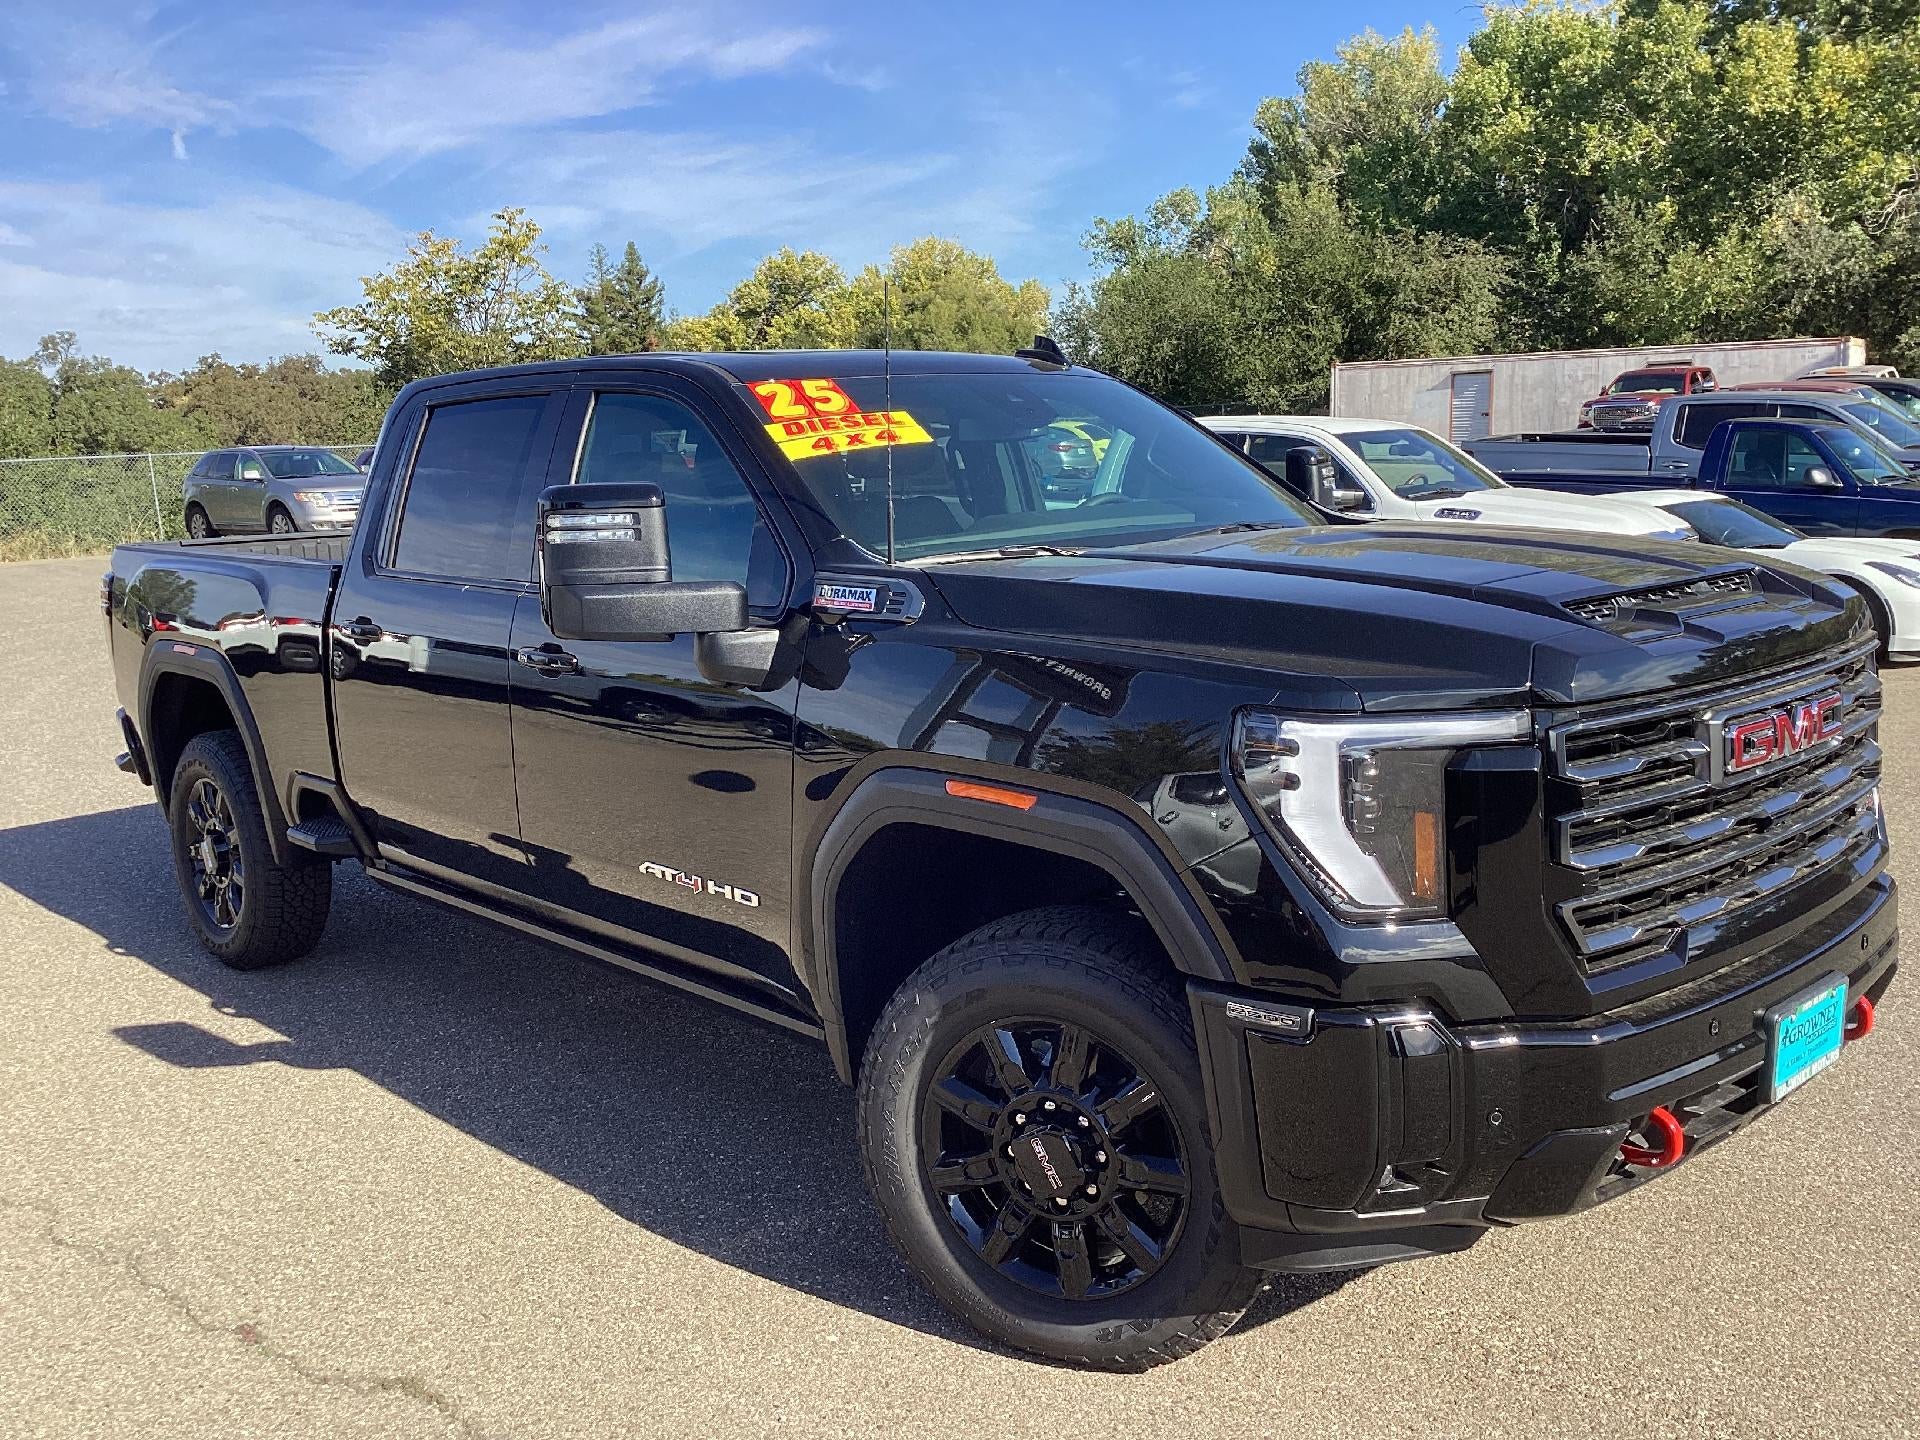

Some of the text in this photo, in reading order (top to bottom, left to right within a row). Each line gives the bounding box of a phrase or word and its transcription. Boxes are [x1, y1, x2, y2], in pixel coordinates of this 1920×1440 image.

[755, 379, 851, 418] 25
[782, 413, 905, 437] DIESEL
[819, 585, 872, 601] DURAMAX
[1729, 691, 1843, 770] GMC
[639, 861, 760, 907] AT4 HD
[1788, 1001, 1839, 1044] GROWNEY
[1031, 1137, 1063, 1190] GMC
